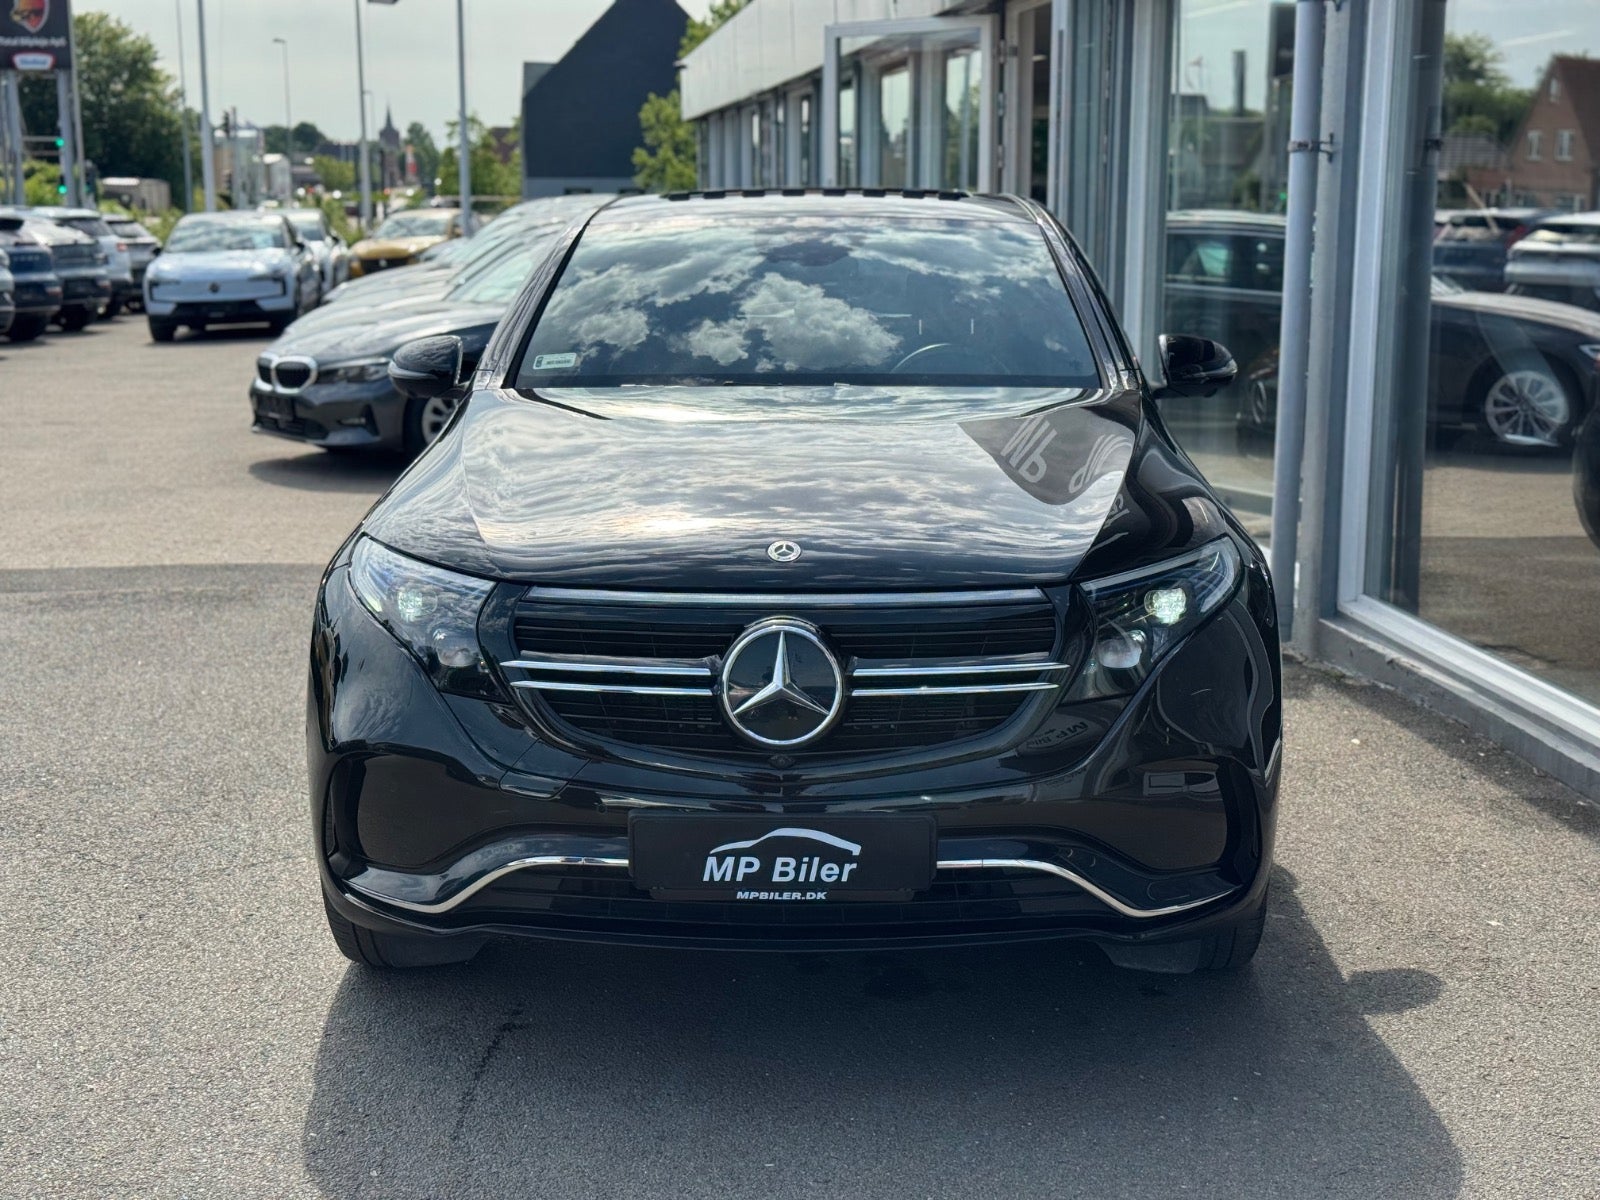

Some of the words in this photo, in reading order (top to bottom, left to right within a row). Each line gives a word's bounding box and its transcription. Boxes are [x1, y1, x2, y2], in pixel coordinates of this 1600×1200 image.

[703, 856, 761, 882] MP
[772, 856, 857, 882] Biler
[736, 891, 828, 900] MPBILER.DK
